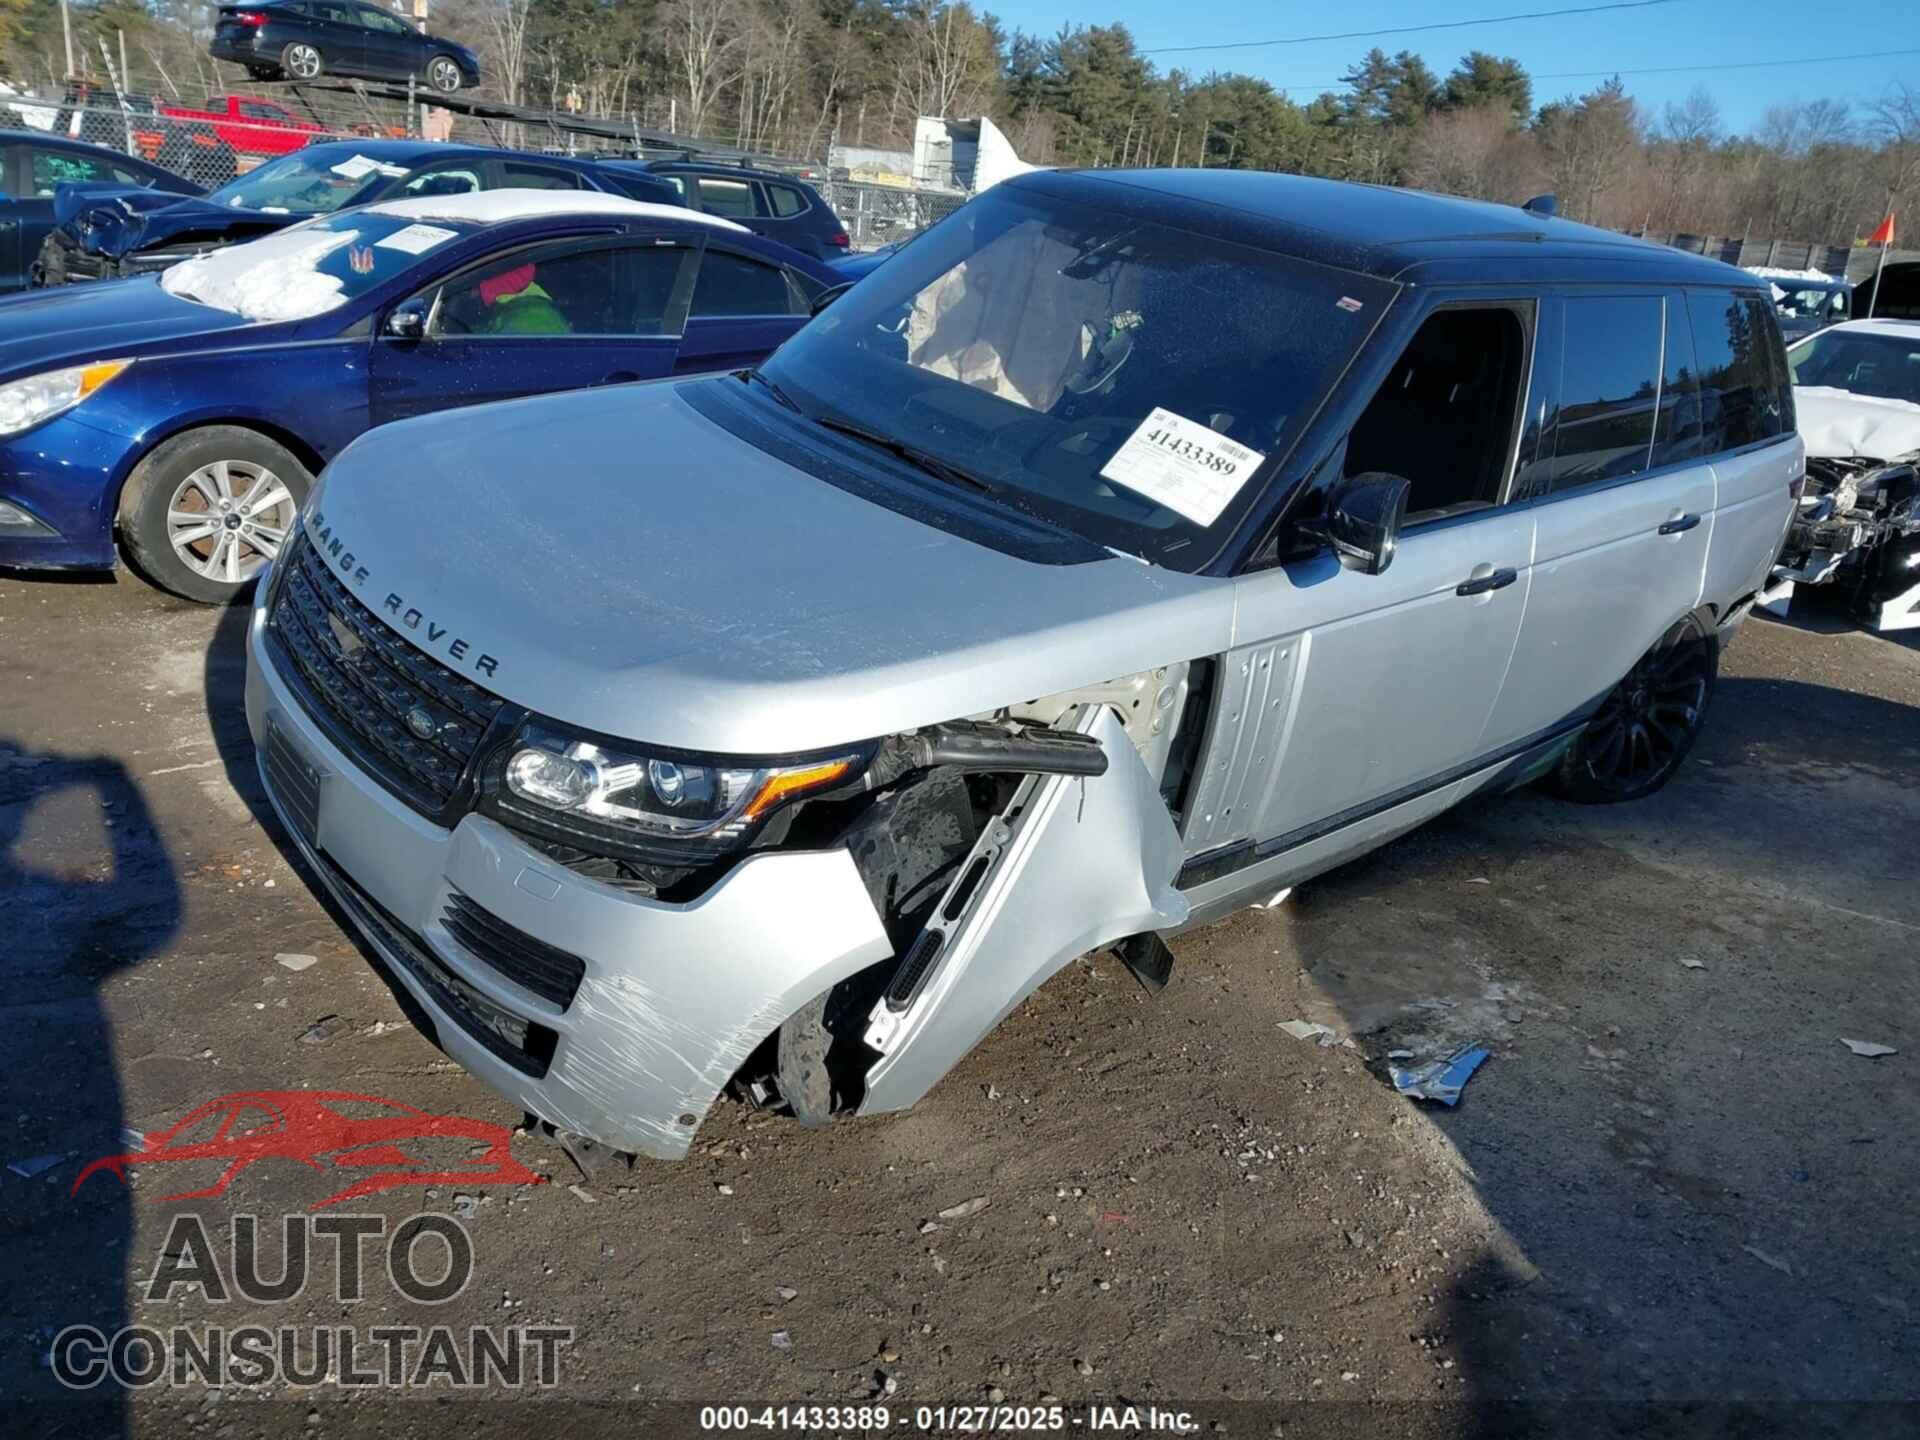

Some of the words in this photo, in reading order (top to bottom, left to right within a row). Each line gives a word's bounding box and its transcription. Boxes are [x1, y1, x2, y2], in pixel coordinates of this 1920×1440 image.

[1147, 429, 1237, 476] 41433389
[311, 511, 370, 586] RANGE
[384, 593, 499, 678] ROVER
